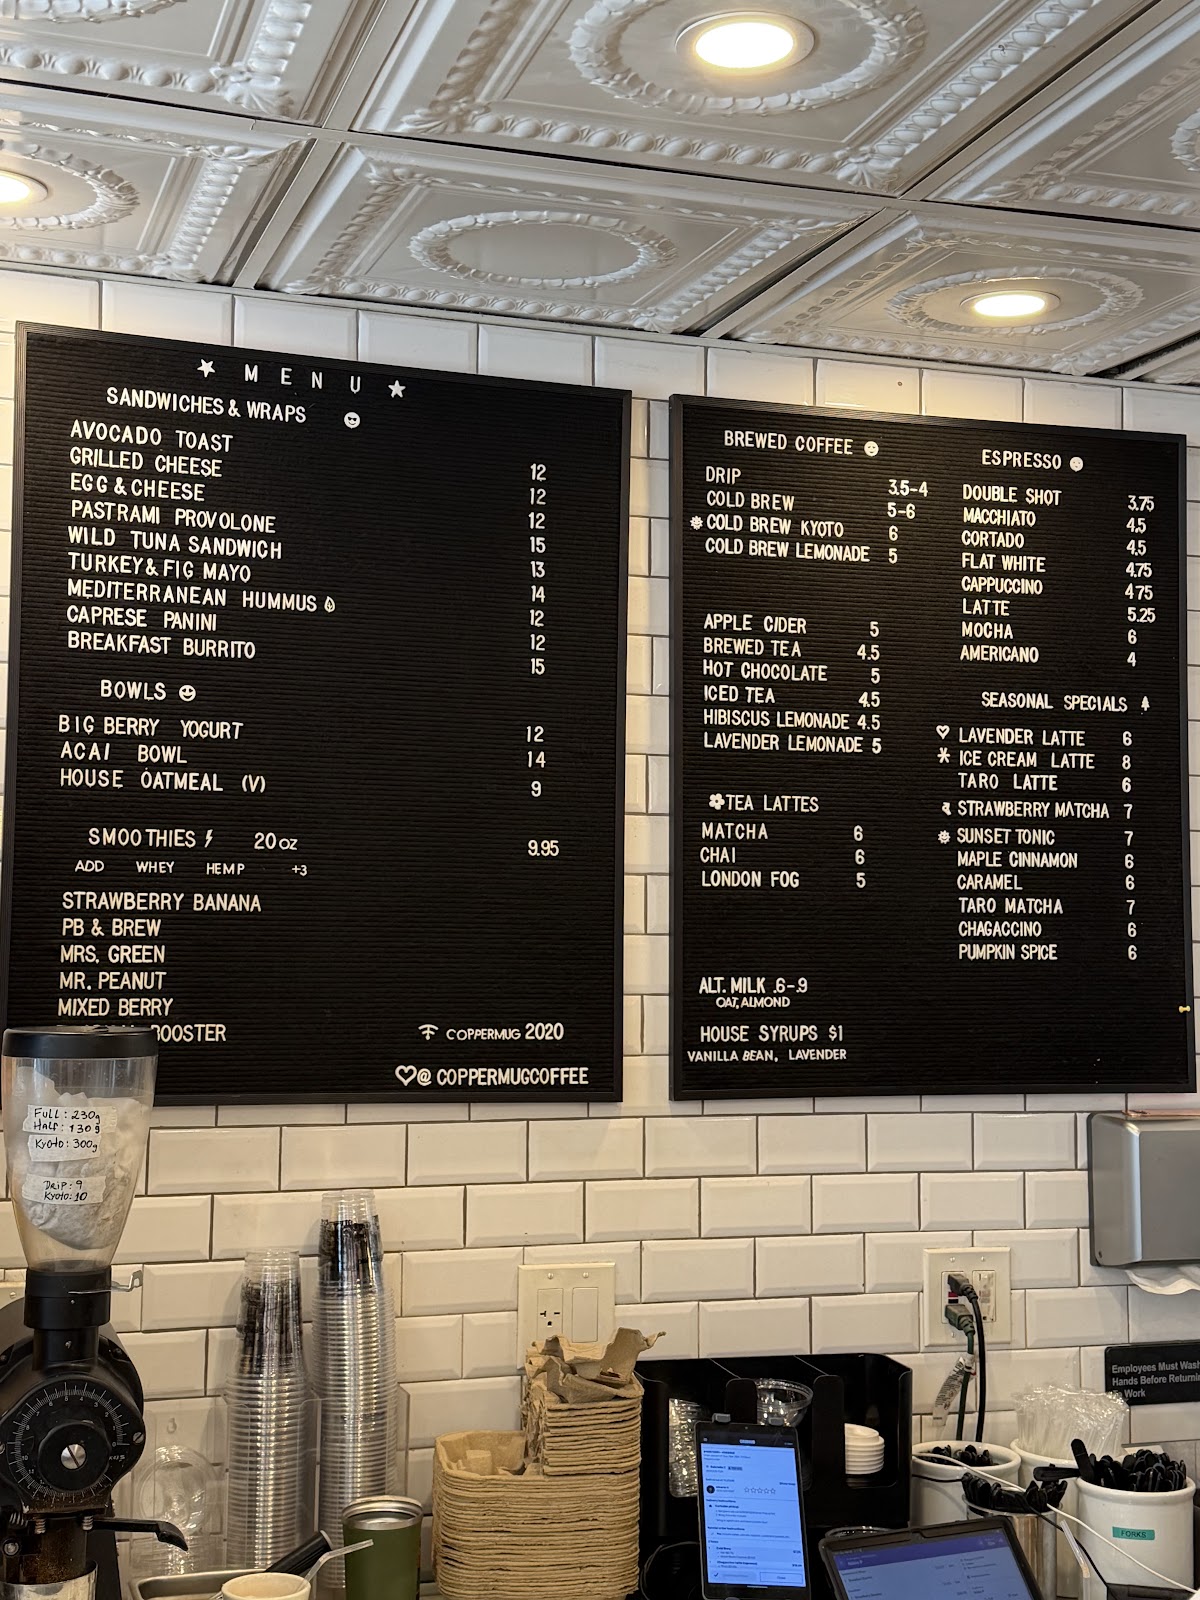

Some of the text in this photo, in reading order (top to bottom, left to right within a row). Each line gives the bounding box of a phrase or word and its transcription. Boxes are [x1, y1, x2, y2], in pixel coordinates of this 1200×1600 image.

[106, 386, 307, 424] SANDWICHES WRAPS
[70, 418, 547, 482] AVOCADO TOAST 12
[724, 429, 854, 455] BREWED COFFEE
[69, 446, 223, 478] GRILLED CHEESE
[981, 448, 1062, 470] ESPRESSO
[705, 465, 742, 485] DRIP
[70, 472, 206, 502] EGG CHEESE
[706, 489, 916, 520] COLD BREW 5-6
[962, 483, 1155, 512] DOUBLE SHOT 3.75
[71, 499, 546, 554] PASTRAMI PROVOLONE 15
[706, 513, 844, 539] COLD BREW KYOTO
[963, 506, 1037, 528] MACCHIATO
[961, 529, 1025, 549] CORTADO
[67, 525, 546, 578] WILD TUNA SANDWICH 13
[705, 537, 871, 563] COLD BREW LEMONADE
[961, 552, 1153, 578] FLAT WHITE 4.75
[163, 558, 546, 603] FIG MAYO 14
[961, 575, 1044, 595] CAPPUCCINO
[67, 578, 318, 612] MEDITERRANEAN HUMMUS
[66, 604, 217, 632] CAPRESE PANINI
[962, 597, 1156, 624] LATTE 5.25
[703, 613, 807, 635] APPLE CIDER
[961, 620, 1014, 640] MOCHA
[67, 630, 256, 660] BREAKFAST BURRITO
[703, 636, 802, 658] BREWED TEA
[959, 644, 1040, 664] AMERICANO
[702, 658, 828, 682] HOT CHOCOLATE
[100, 679, 167, 701] BOWLS
[703, 684, 776, 704] ICED TEA
[981, 691, 1128, 713] SEASONAL SPECIALS
[58, 714, 244, 740] BIG BERRY YOGURT
[703, 708, 850, 730] HIBISCUS LEMONADE
[703, 731, 864, 753] LAVENDER LEMONADE
[958, 726, 1086, 747] LAVENDER LATTE
[60, 740, 188, 764] ACAI BOWL
[959, 749, 1132, 770] ICE CREAM LATTE 8
[60, 767, 266, 793] HOUSE OATMEAL (V)
[957, 772, 1058, 791] TARO LATTE
[725, 793, 820, 813] TEA LATTES
[957, 799, 1051, 818] STRAWBERRY
[701, 821, 769, 841] MATCHA
[956, 827, 1134, 847] SUNSET TONIC 7
[88, 827, 560, 857] SMOOTHIES 9.95
[699, 846, 736, 864] CHAI
[957, 850, 1078, 869] MAPLE CINNAMON
[74, 859, 308, 877] ADD WHEY HEMP +3
[701, 869, 800, 888] LONDON FOG
[956, 873, 1023, 891] CARAMEL
[62, 890, 262, 912] STRAWBERRY BANANA
[958, 896, 1064, 915] TARO MATCHA
[62, 917, 162, 937] PB BREW
[958, 920, 1042, 938] CHAGACCINO
[60, 944, 166, 964] MRS. GREEN
[958, 943, 1058, 961] PUMPKIN SPICE
[59, 971, 167, 991] MR. PEANUT
[698, 976, 727, 995] ALT.
[730, 976, 766, 995] MILK
[57, 997, 174, 1017] MIXED BERRY
[445, 1022, 565, 1041] COPPERMUG 2020
[700, 1024, 843, 1043] HOUSE SYRUPS $1
[687, 1048, 847, 1063] VANILLA BEAN, LAVENDER
[75, 1180, 83, 1189] 9
[74, 1191, 88, 1202] 10
[1112, 1364, 1157, 1374] Employees
[1158, 1362, 1178, 1371] Must
[1112, 1377, 1138, 1386] Hands
[1140, 1375, 1167, 1385] Before
[1124, 1388, 1146, 1398] Work
[1120, 1530, 1147, 1539] FORKS
